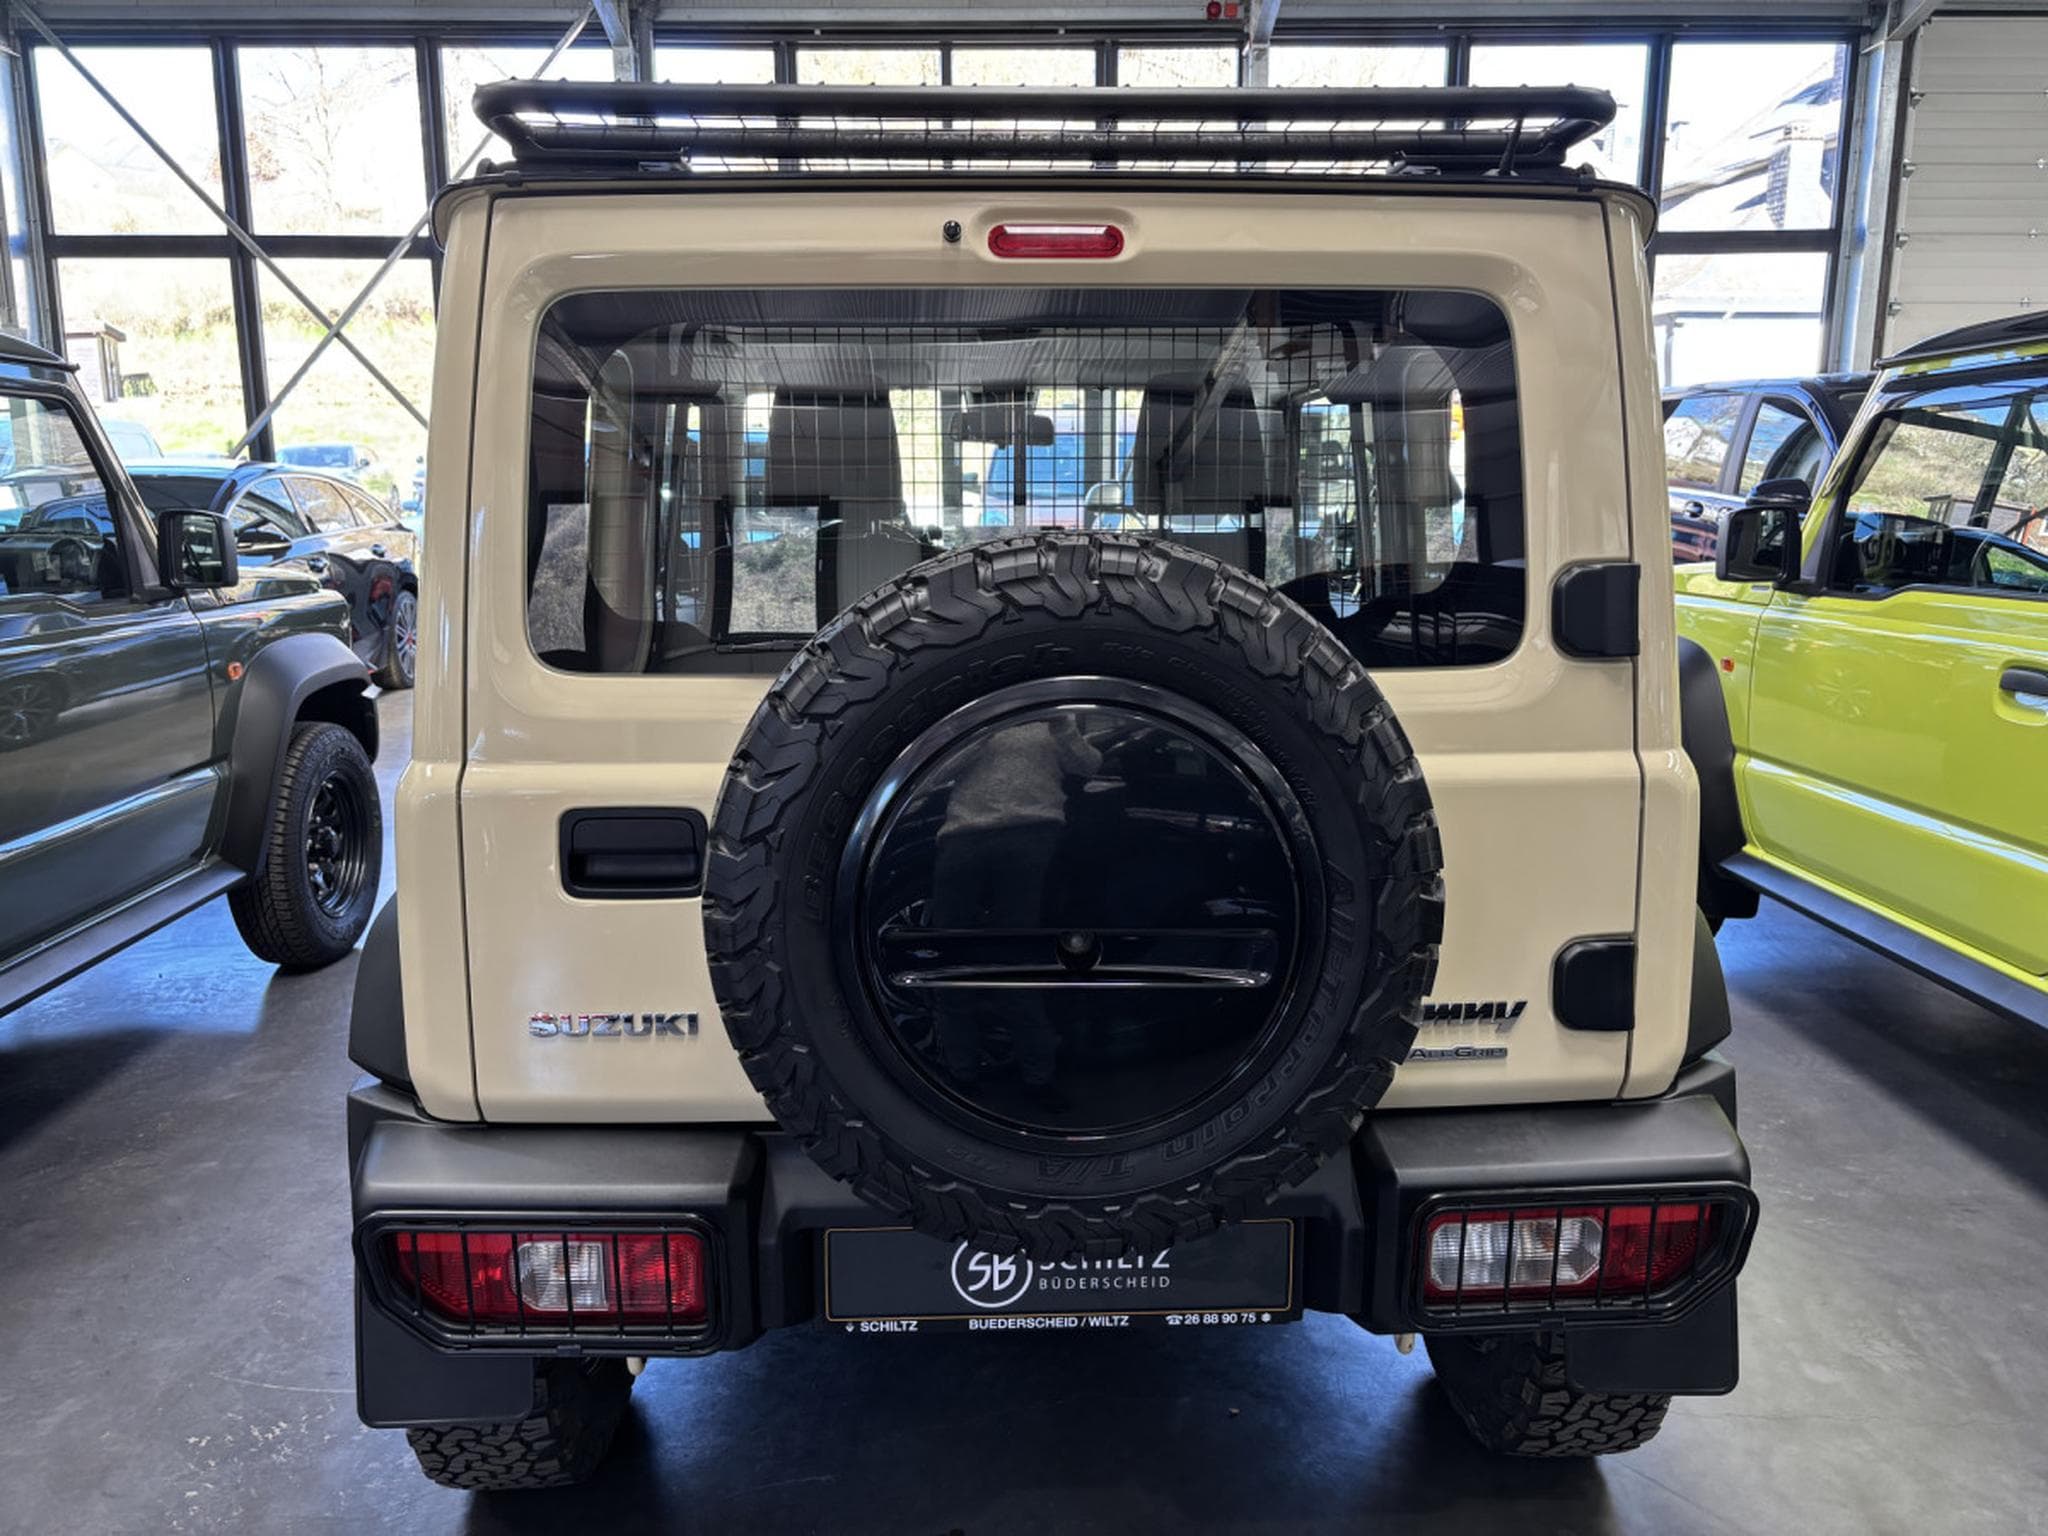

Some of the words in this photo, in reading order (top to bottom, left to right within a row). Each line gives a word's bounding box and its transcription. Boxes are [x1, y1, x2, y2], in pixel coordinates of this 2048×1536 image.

[528, 1012, 699, 1037] SUZUKI
[1039, 1275, 1170, 1291] BÜDERSCHEID
[860, 1320, 918, 1333] SCHILTZ
[969, 1316, 1078, 1330] BUEDERSCHEID
